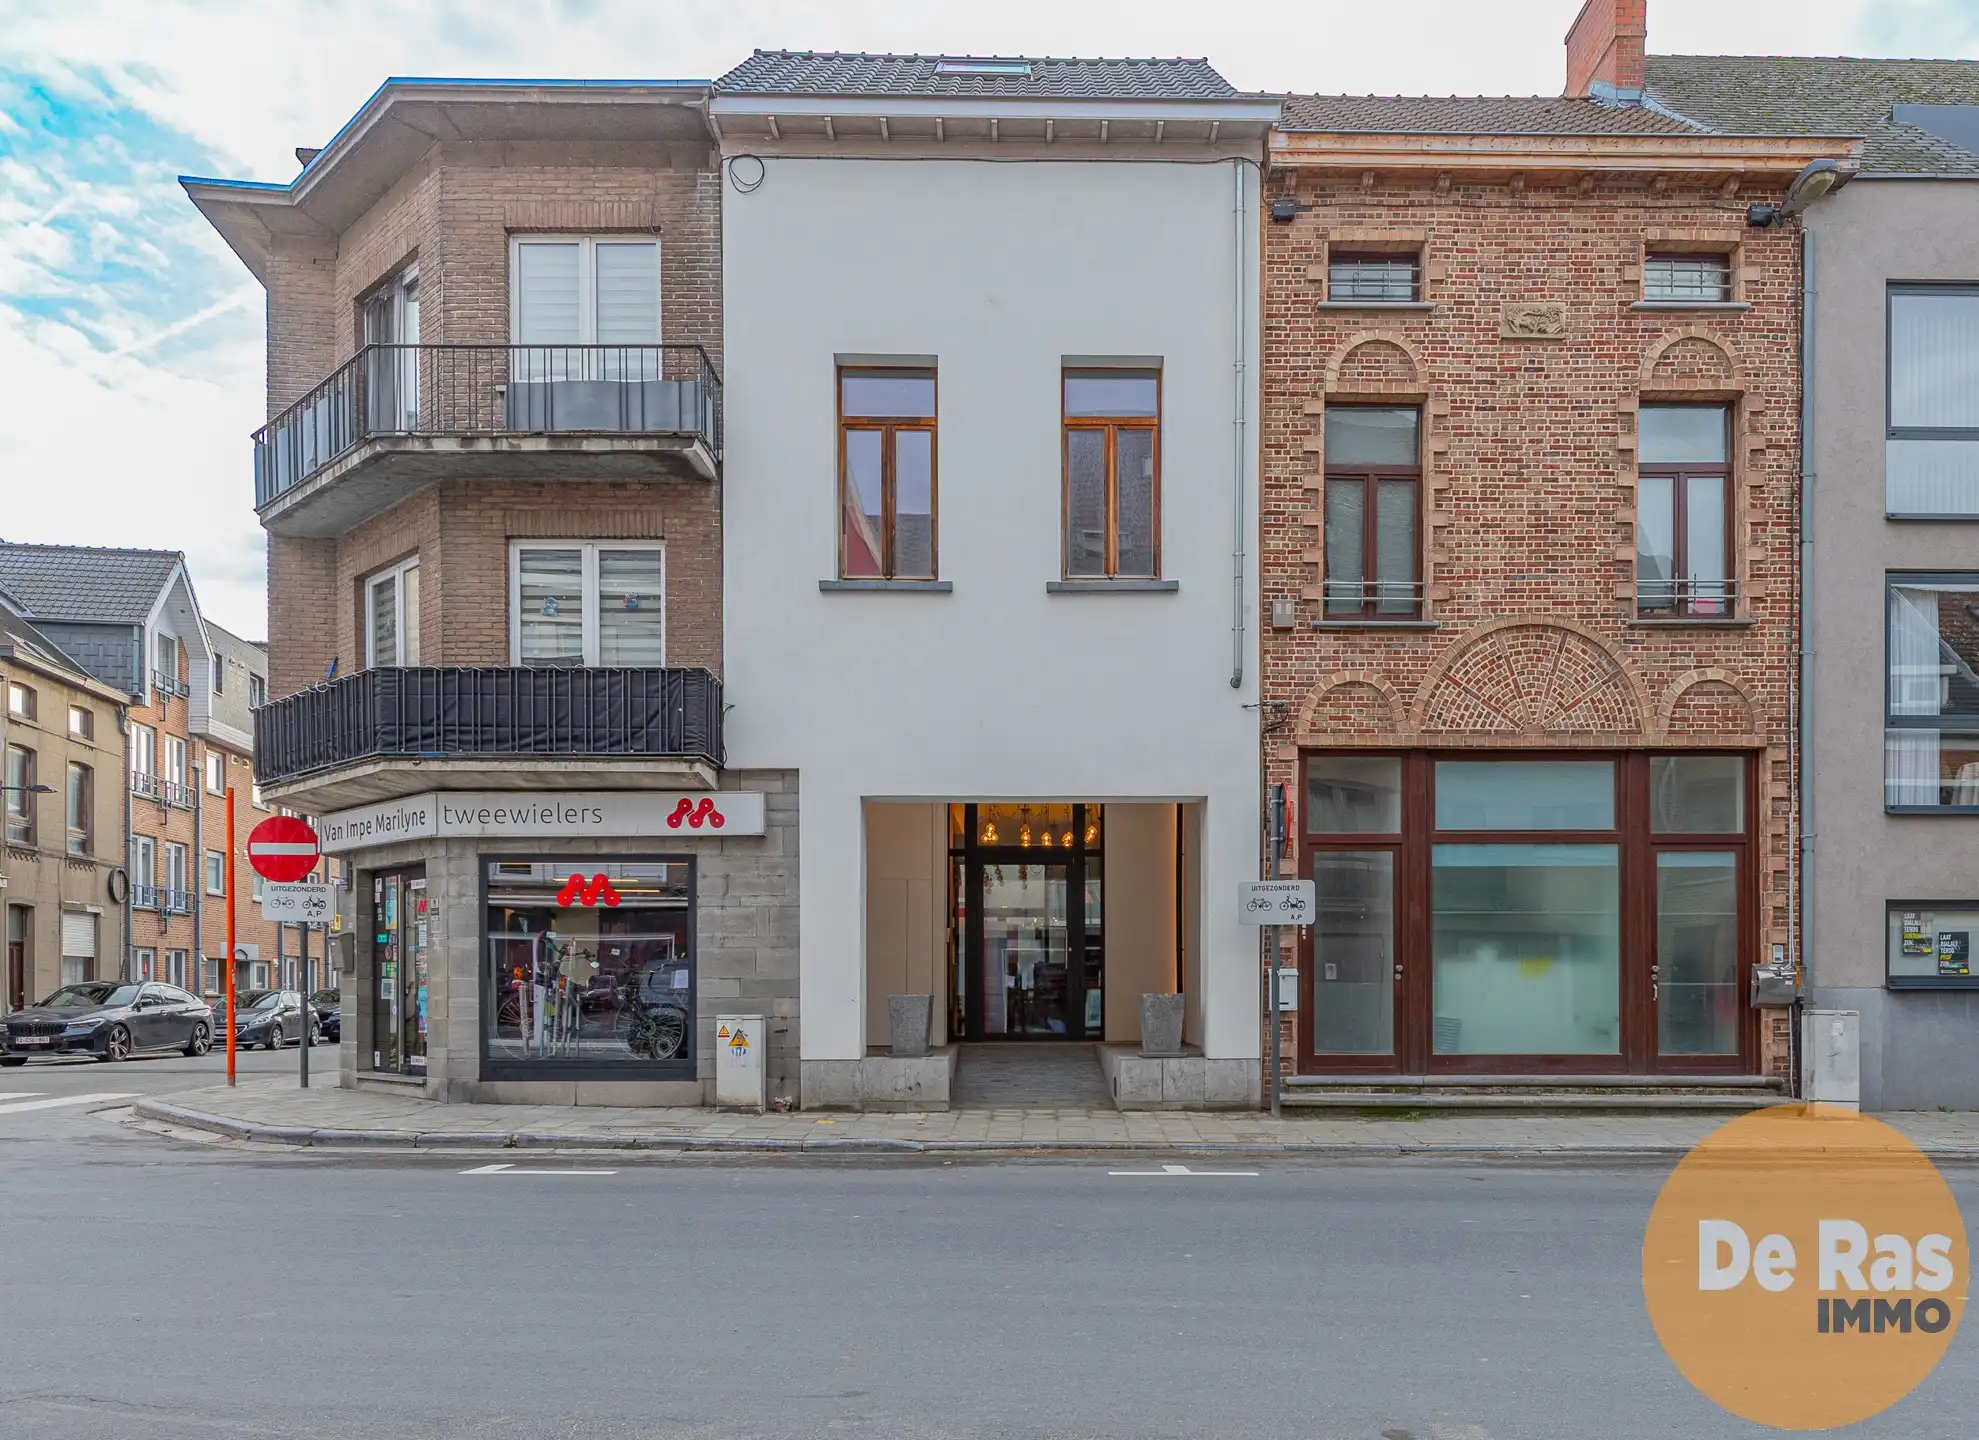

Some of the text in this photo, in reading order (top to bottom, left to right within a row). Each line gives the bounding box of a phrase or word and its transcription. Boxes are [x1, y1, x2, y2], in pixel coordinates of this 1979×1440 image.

[323, 807, 426, 842] Van Impe Marilyne
[443, 802, 603, 825] tweewielers
[270, 885, 327, 893] UITGEZONDERD
